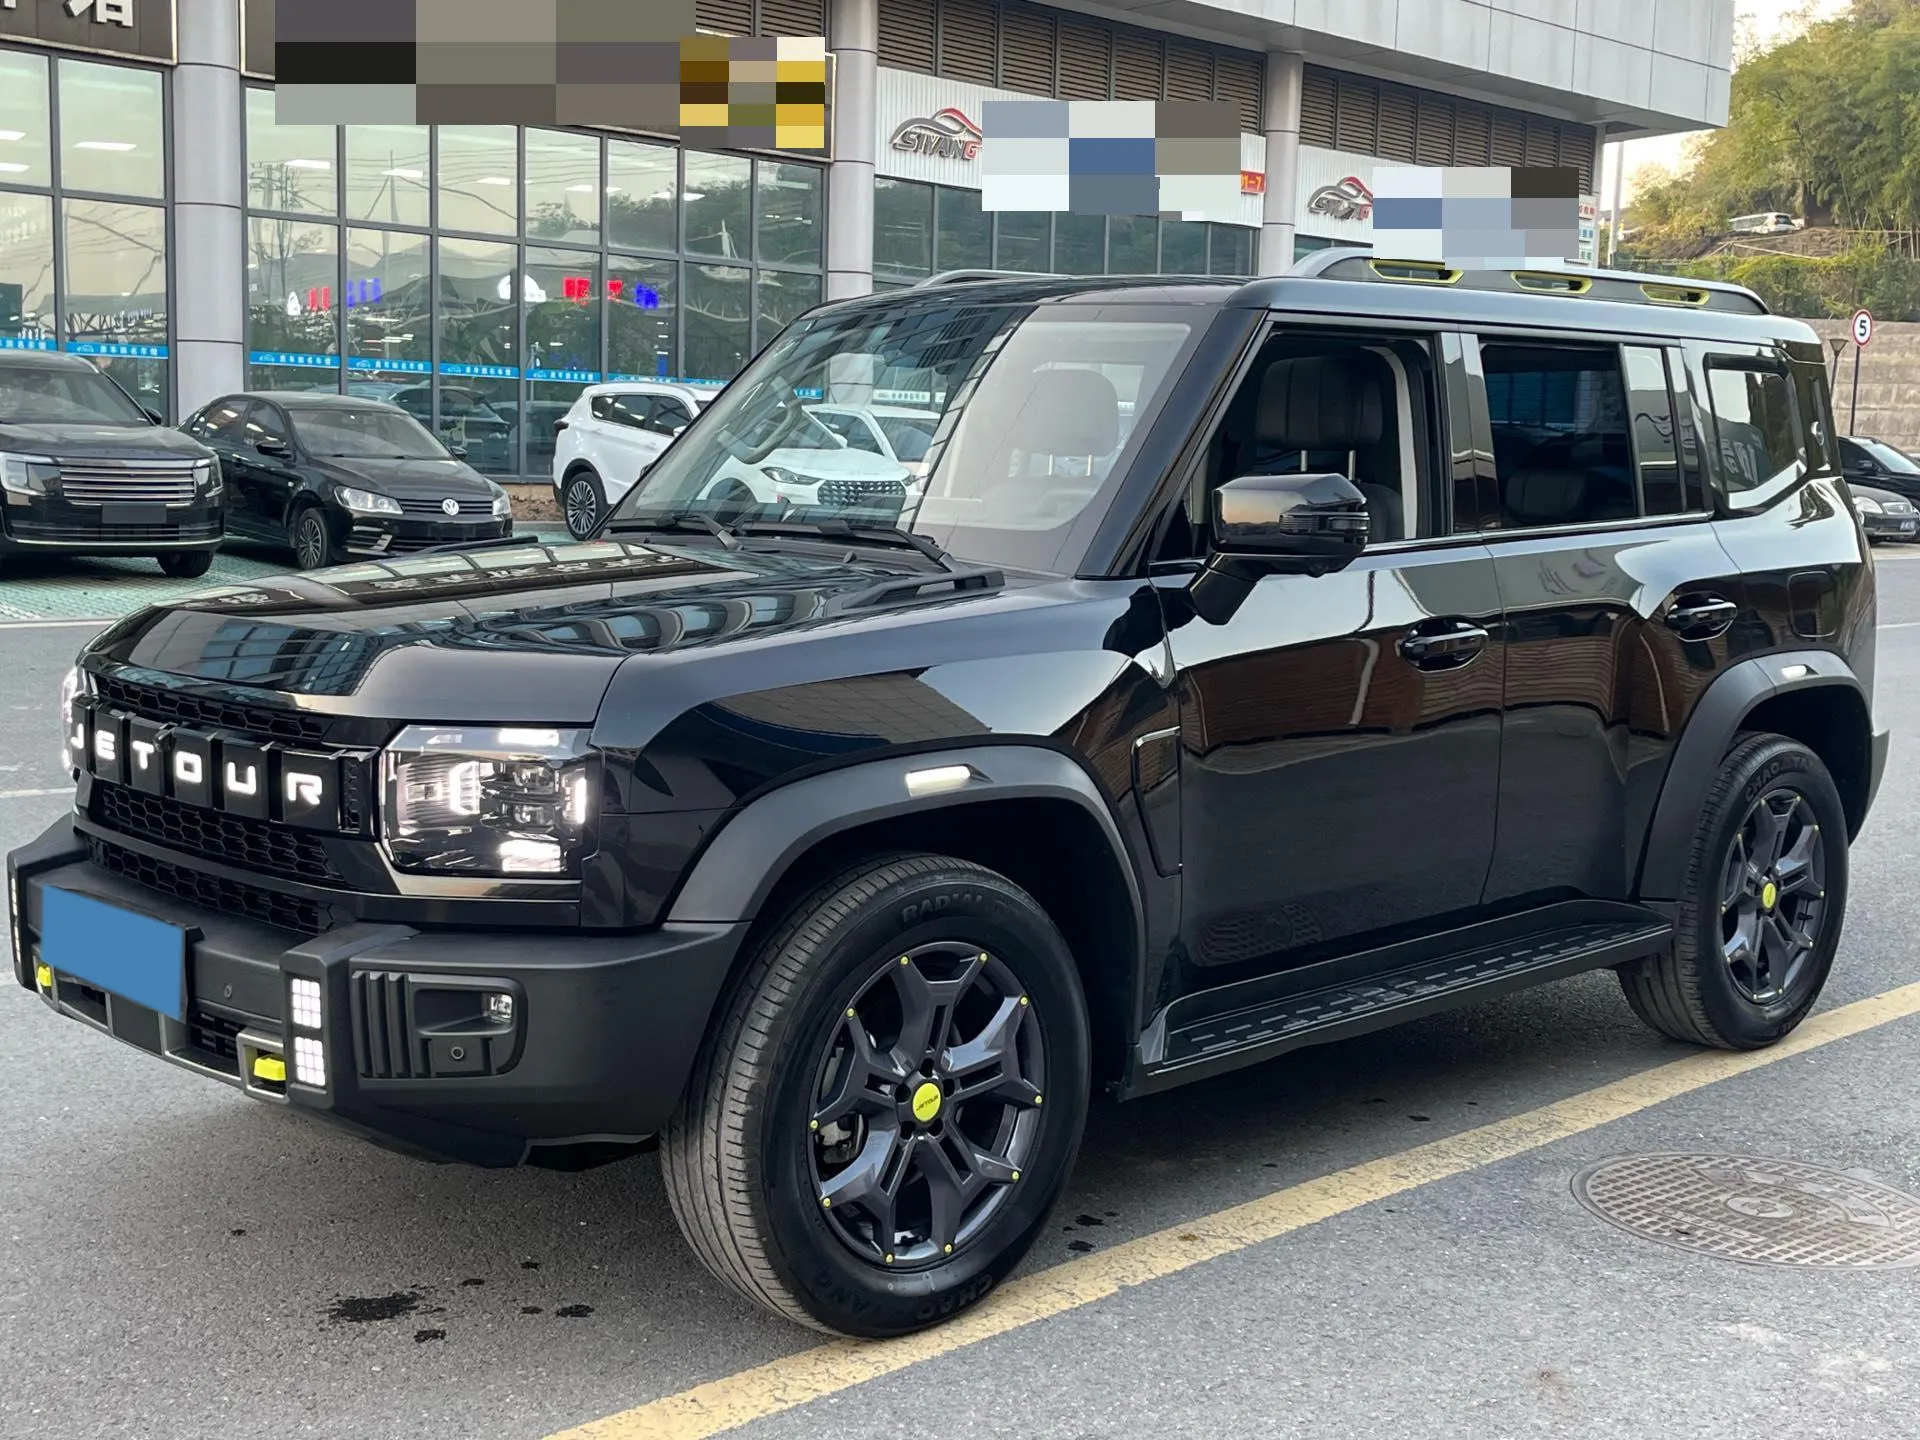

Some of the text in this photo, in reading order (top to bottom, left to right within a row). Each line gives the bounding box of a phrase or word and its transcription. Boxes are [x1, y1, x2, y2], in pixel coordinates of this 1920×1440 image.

[892, 130, 983, 161] SIYANG
[1859, 319, 1868, 337] 5
[70, 723, 324, 807] JETOUR
